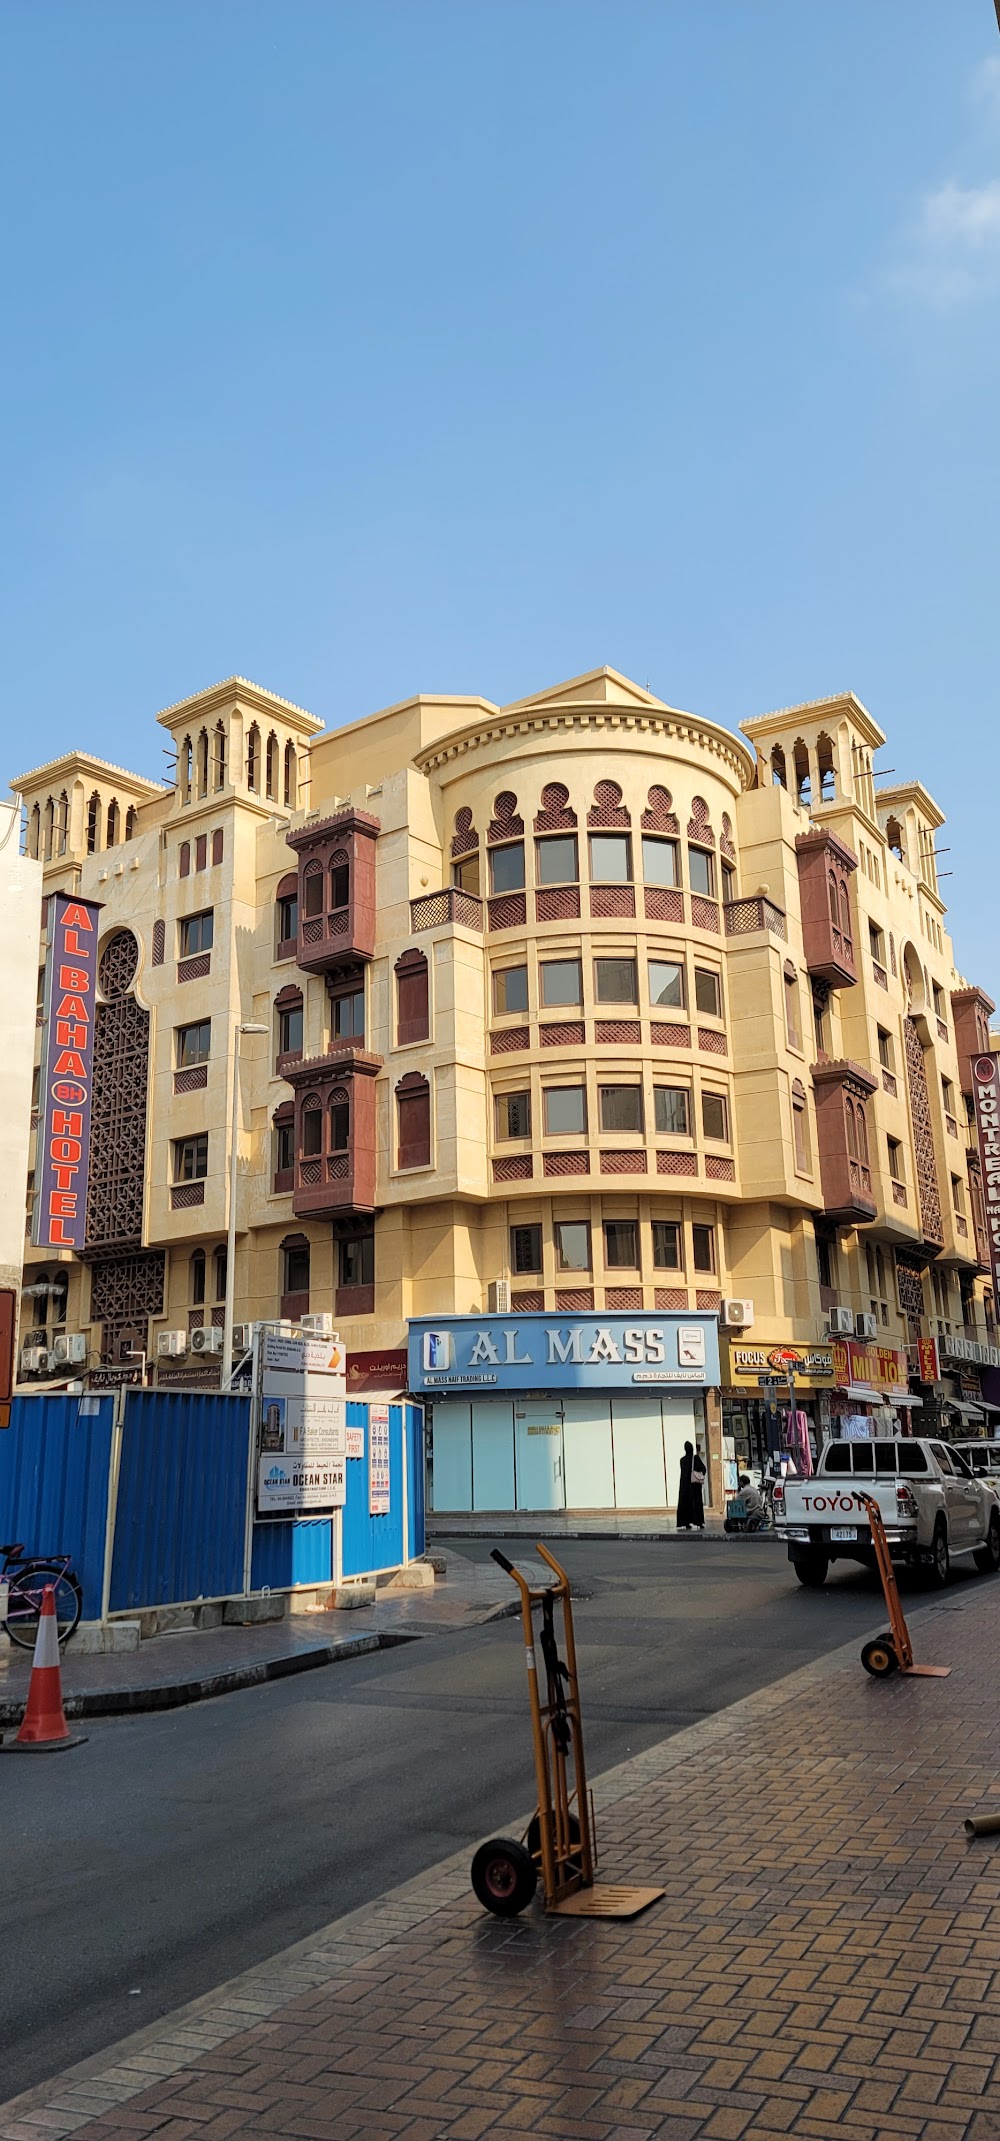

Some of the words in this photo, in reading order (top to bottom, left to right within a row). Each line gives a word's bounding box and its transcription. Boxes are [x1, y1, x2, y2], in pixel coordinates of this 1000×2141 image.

[60, 903, 95, 958] AL
[53, 964, 91, 1079] BAHA
[56, 1085, 84, 1103] BH
[977, 1084, 1000, 1203] MONTREAL
[48, 1110, 84, 1246] HOTEL
[467, 1329, 534, 1366] AL
[545, 1328, 666, 1364] MASS
[735, 1350, 766, 1364] FOCUS
[865, 1346, 893, 1359] GOLDEN
[852, 1355, 907, 1385] MILLION
[921, 1345, 935, 1380] MILLION
[433, 1376, 448, 1384] MASS
[448, 1375, 460, 1383] NAIF
[460, 1375, 482, 1383] TRADING
[346, 1432, 362, 1441] SAFETY
[348, 1444, 360, 1453] FIRST
[293, 1474, 320, 1487] OCEAN
[322, 1472, 343, 1485] STAR
